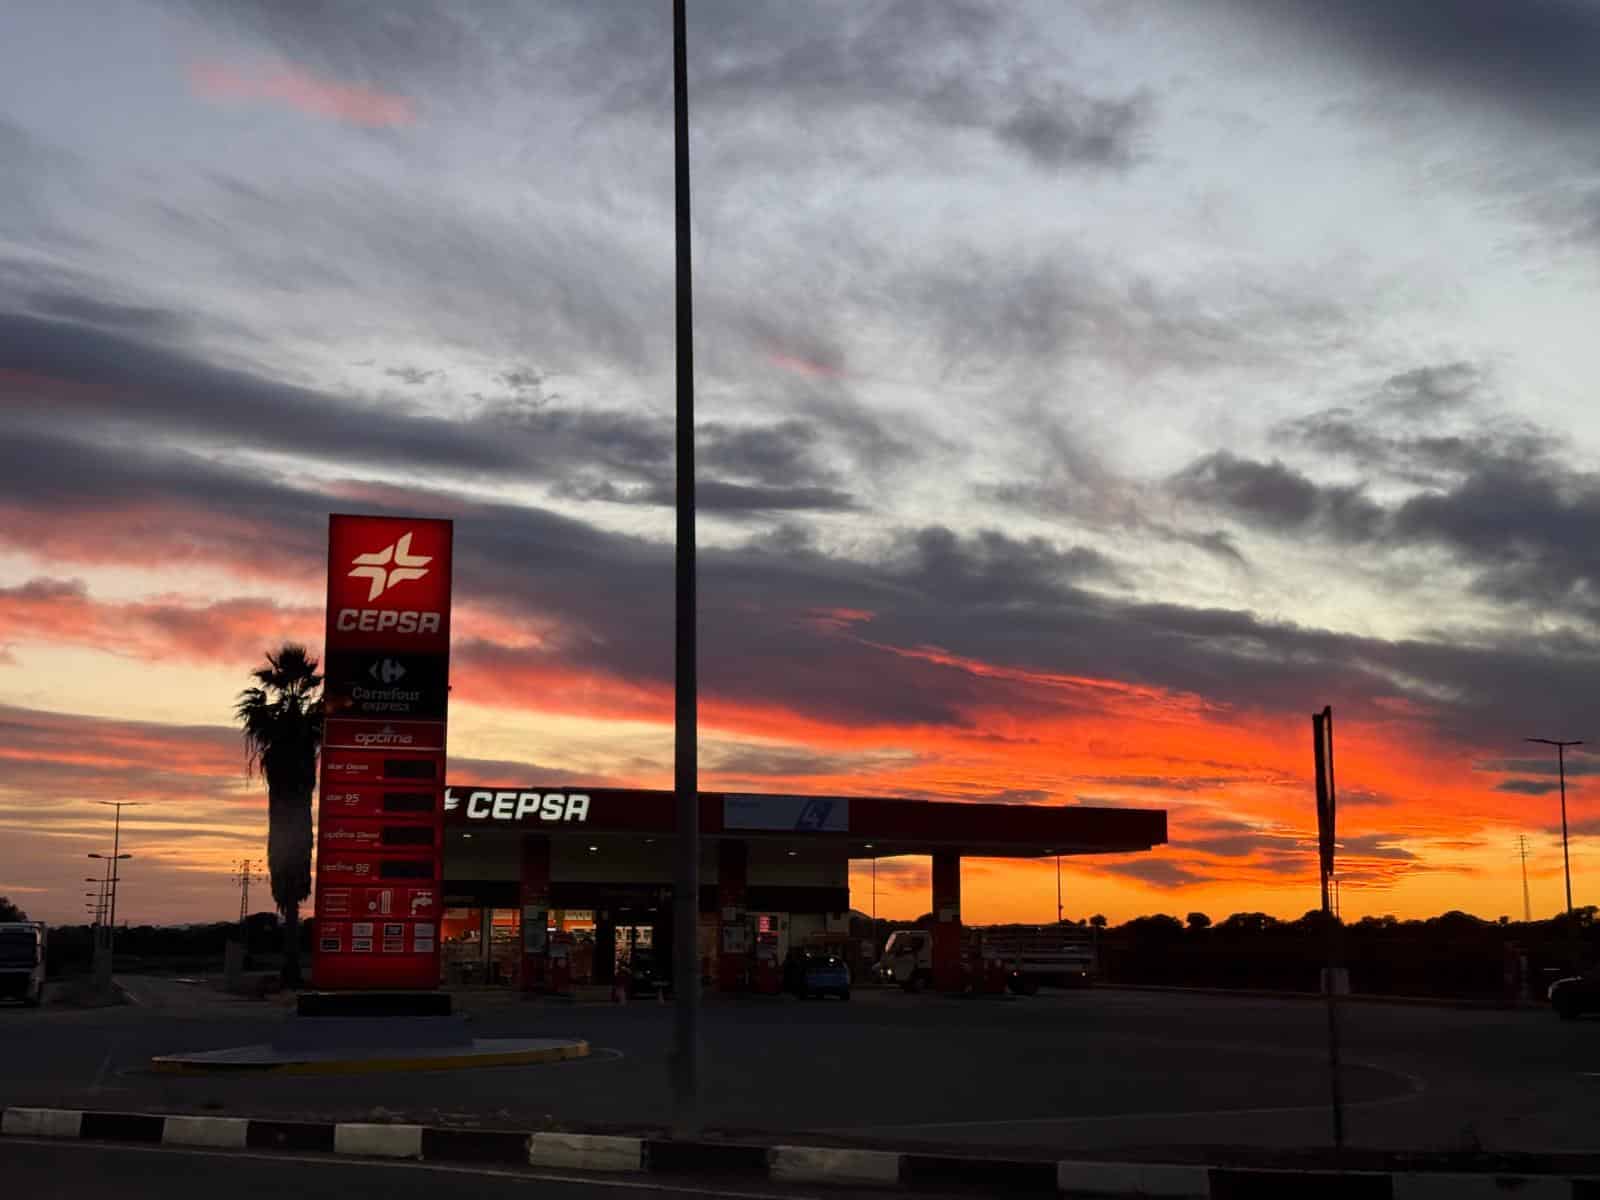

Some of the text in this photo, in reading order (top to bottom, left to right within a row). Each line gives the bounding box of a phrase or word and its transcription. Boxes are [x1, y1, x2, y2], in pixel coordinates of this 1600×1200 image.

[336, 608, 441, 634] CEPSA
[352, 686, 421, 701] Carrefour
[354, 733, 413, 746] optima
[466, 791, 591, 822] CEPSA
